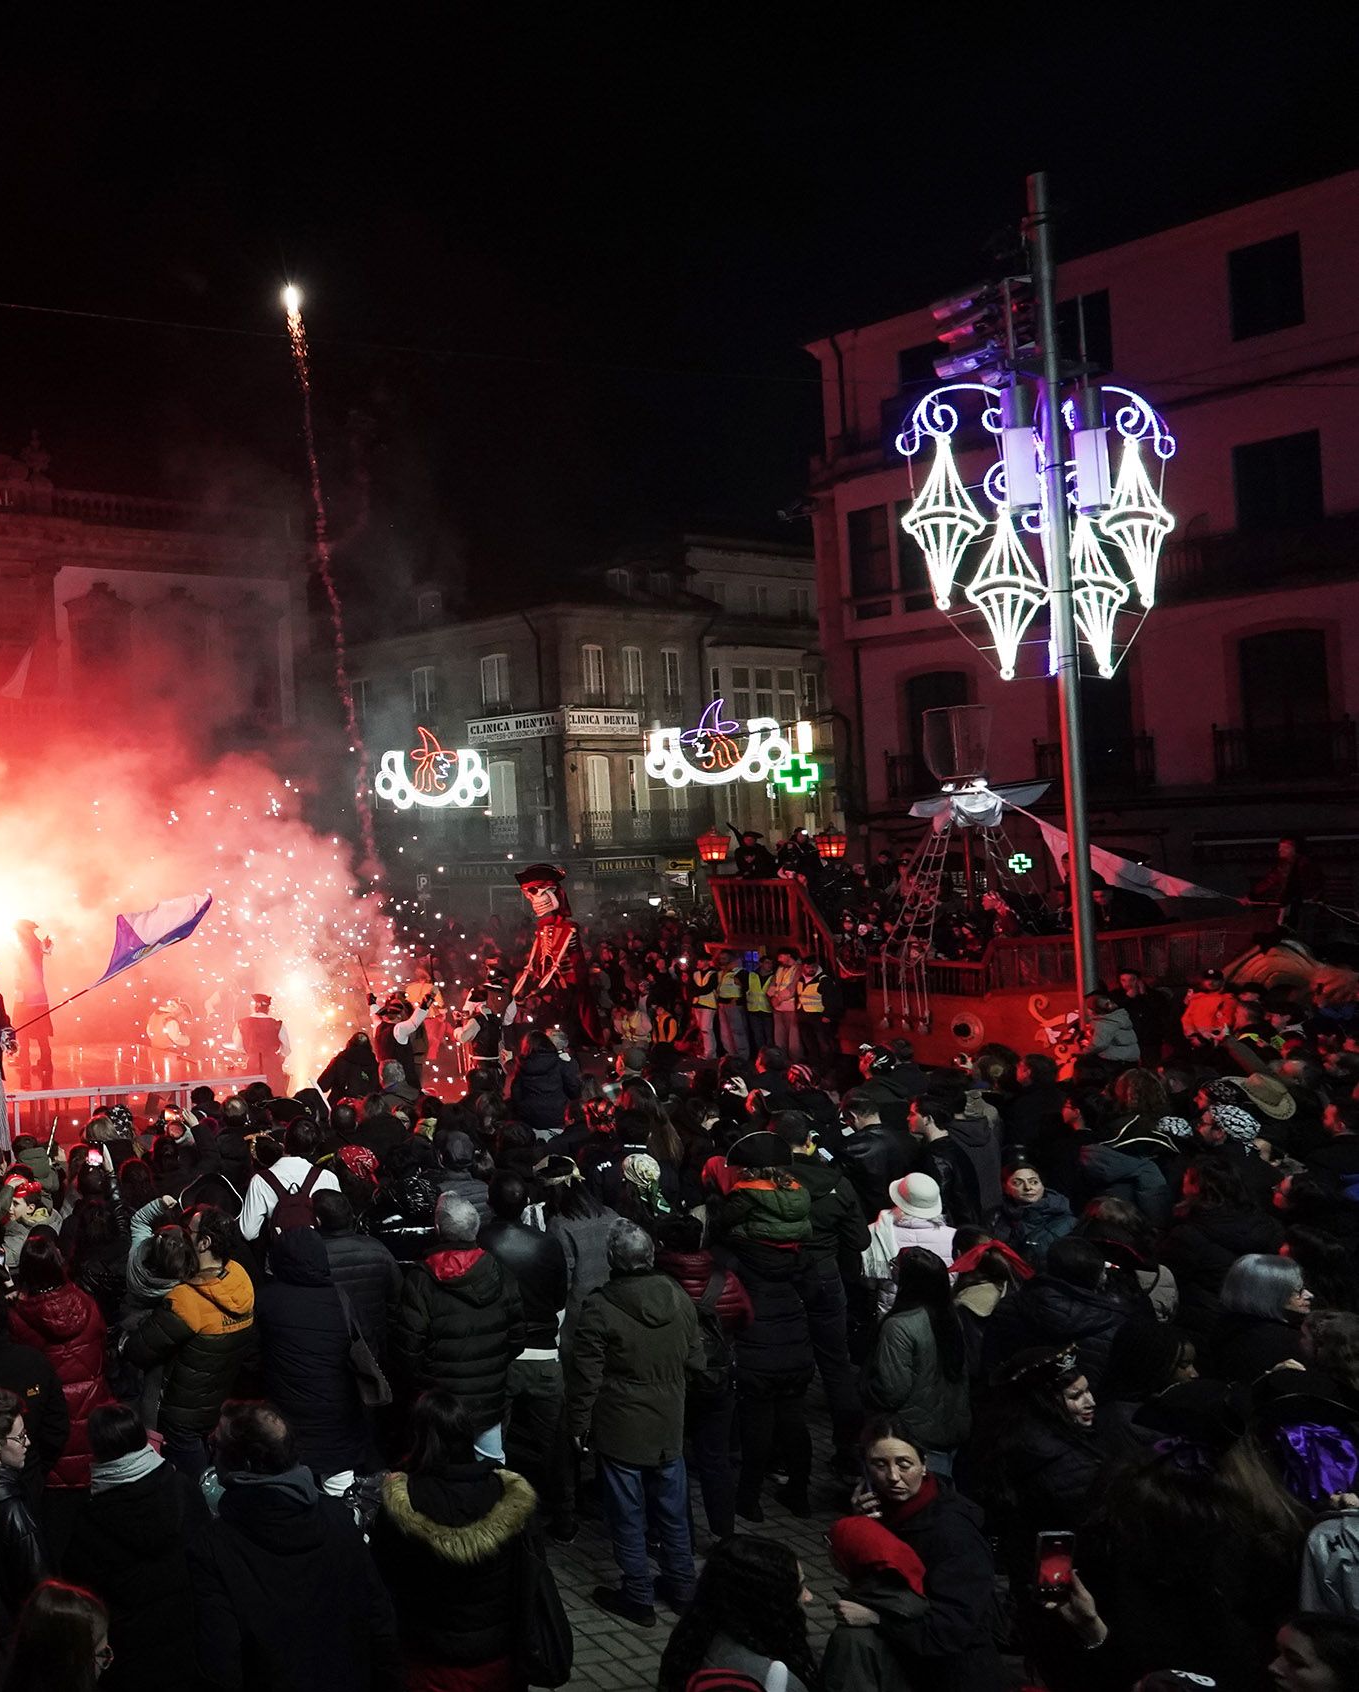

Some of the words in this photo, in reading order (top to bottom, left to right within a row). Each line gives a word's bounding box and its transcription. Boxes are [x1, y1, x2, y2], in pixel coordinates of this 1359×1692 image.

[470, 721, 510, 735] CLINICA
[515, 715, 559, 730] DENTAL
[603, 715, 638, 725] DENTAL
